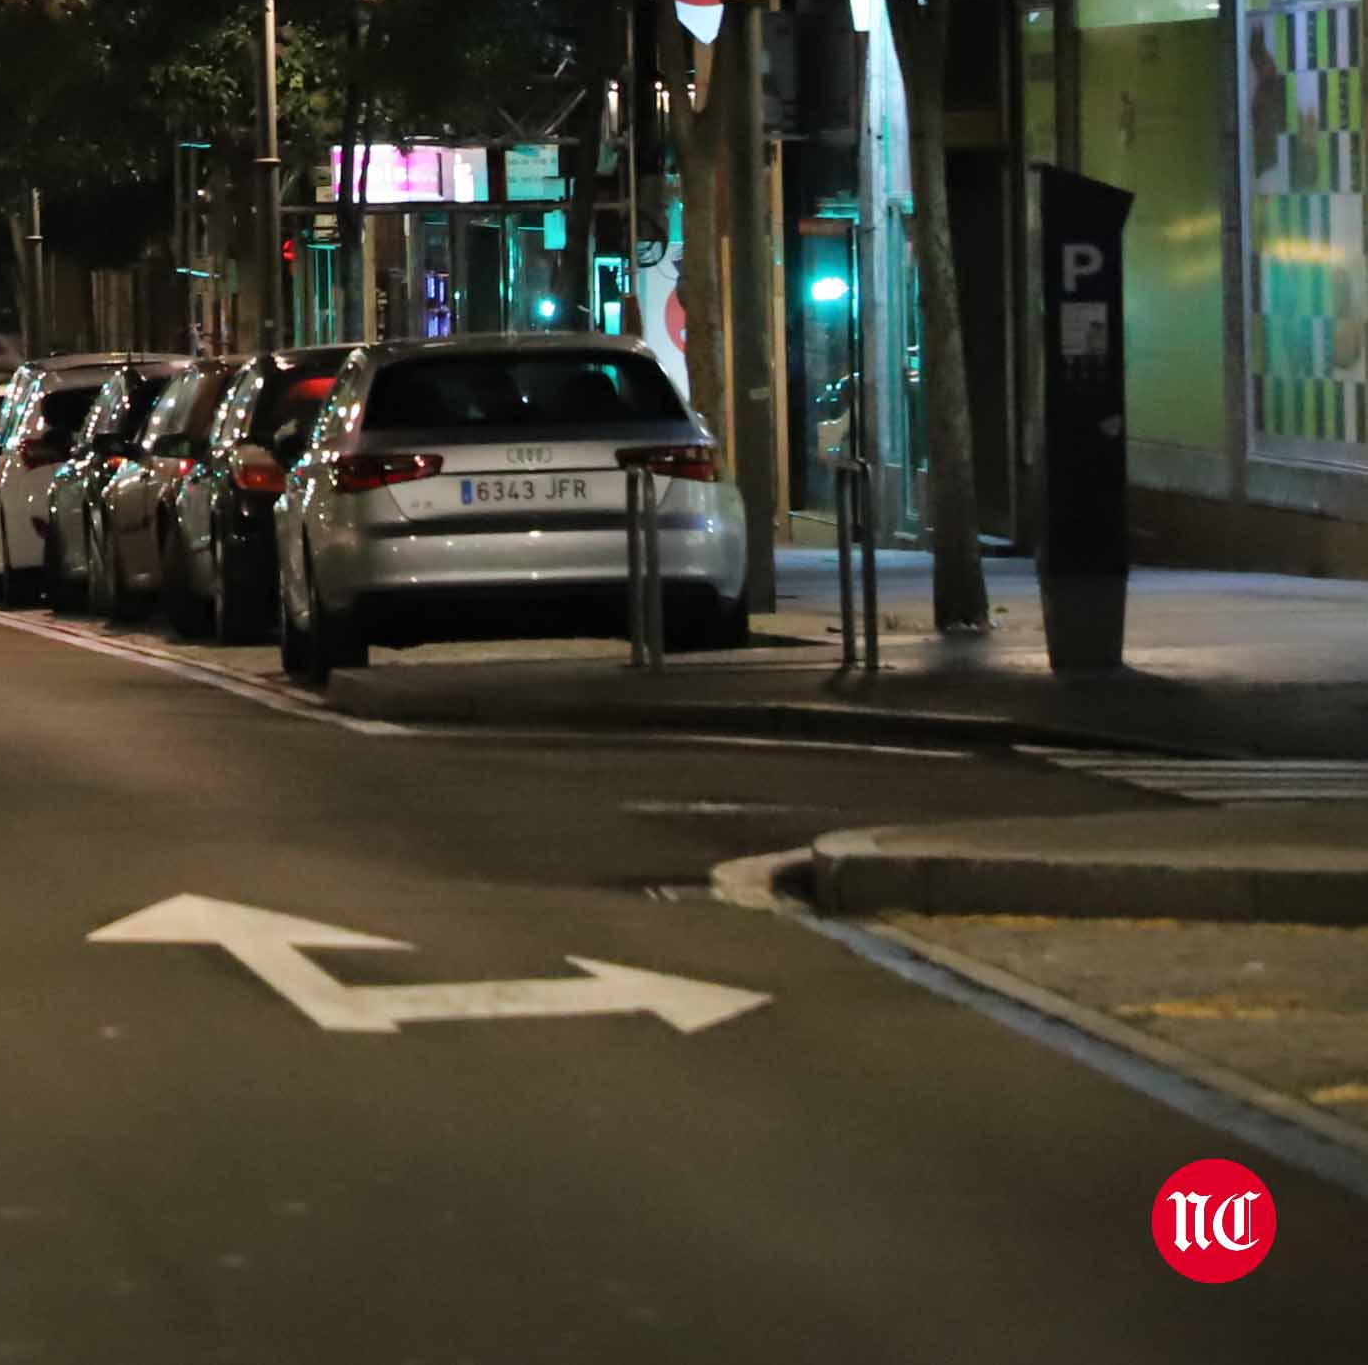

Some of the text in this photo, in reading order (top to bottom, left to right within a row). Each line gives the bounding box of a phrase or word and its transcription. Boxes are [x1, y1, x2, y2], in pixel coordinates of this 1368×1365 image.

[1062, 243, 1104, 292] P
[476, 479, 588, 501] 6343 JFR
